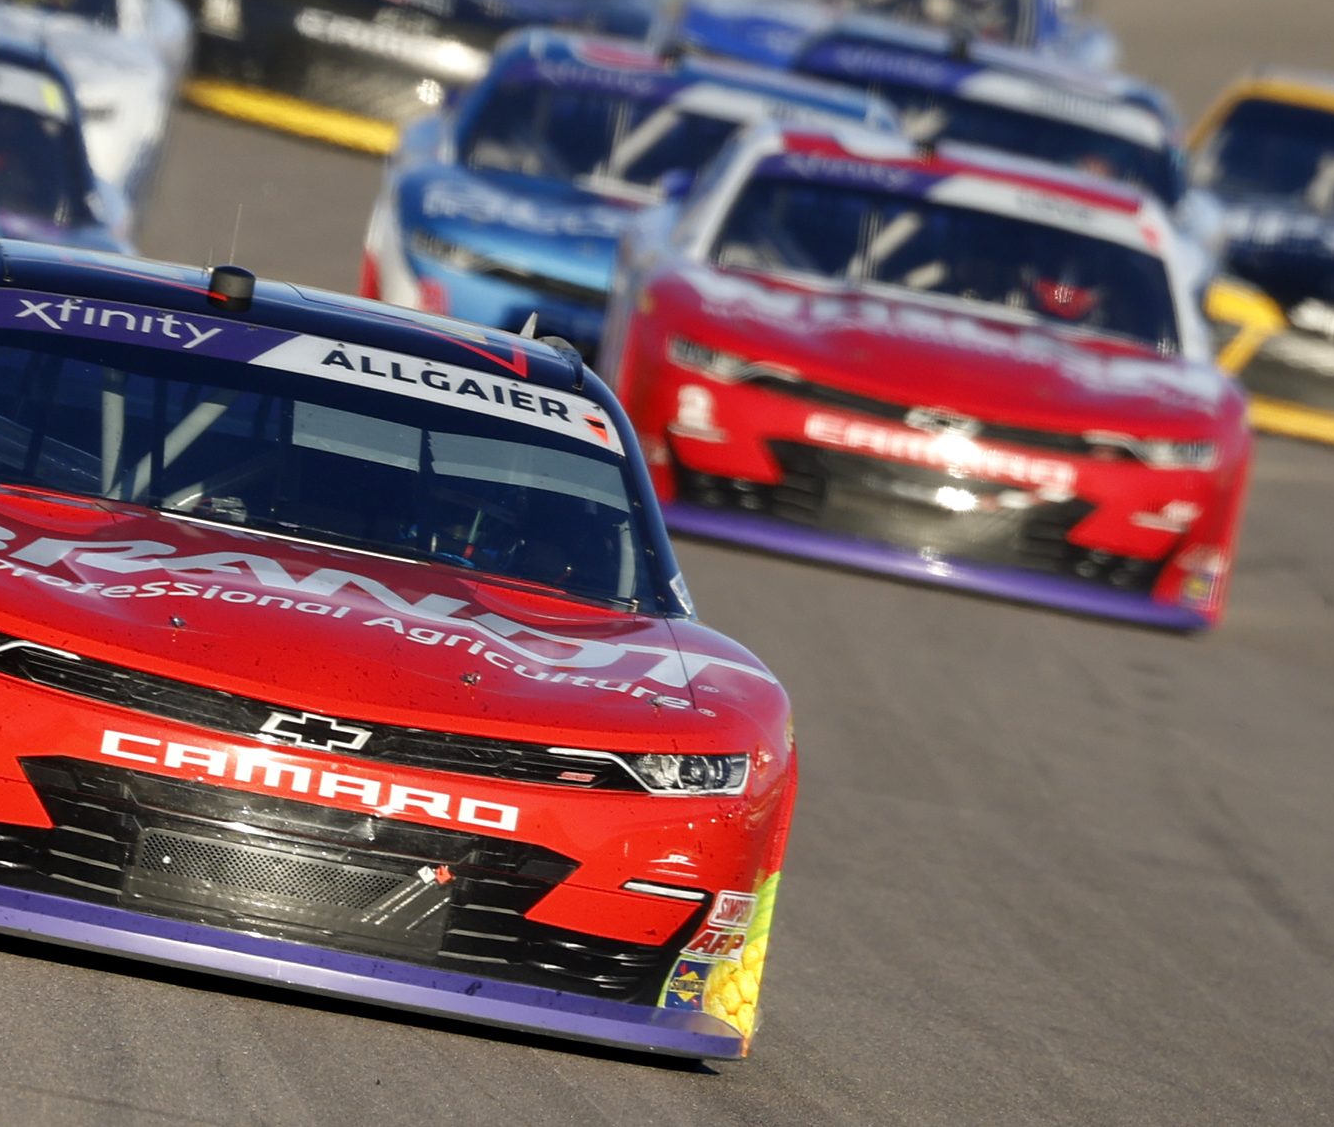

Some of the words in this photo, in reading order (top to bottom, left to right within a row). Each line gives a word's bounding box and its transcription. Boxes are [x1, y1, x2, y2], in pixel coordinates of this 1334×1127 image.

[15, 297, 223, 349] xfinity
[321, 349, 573, 425] ALLGAIER
[364, 616, 692, 710] Agriculture
[100, 729, 520, 832] CAMARO
